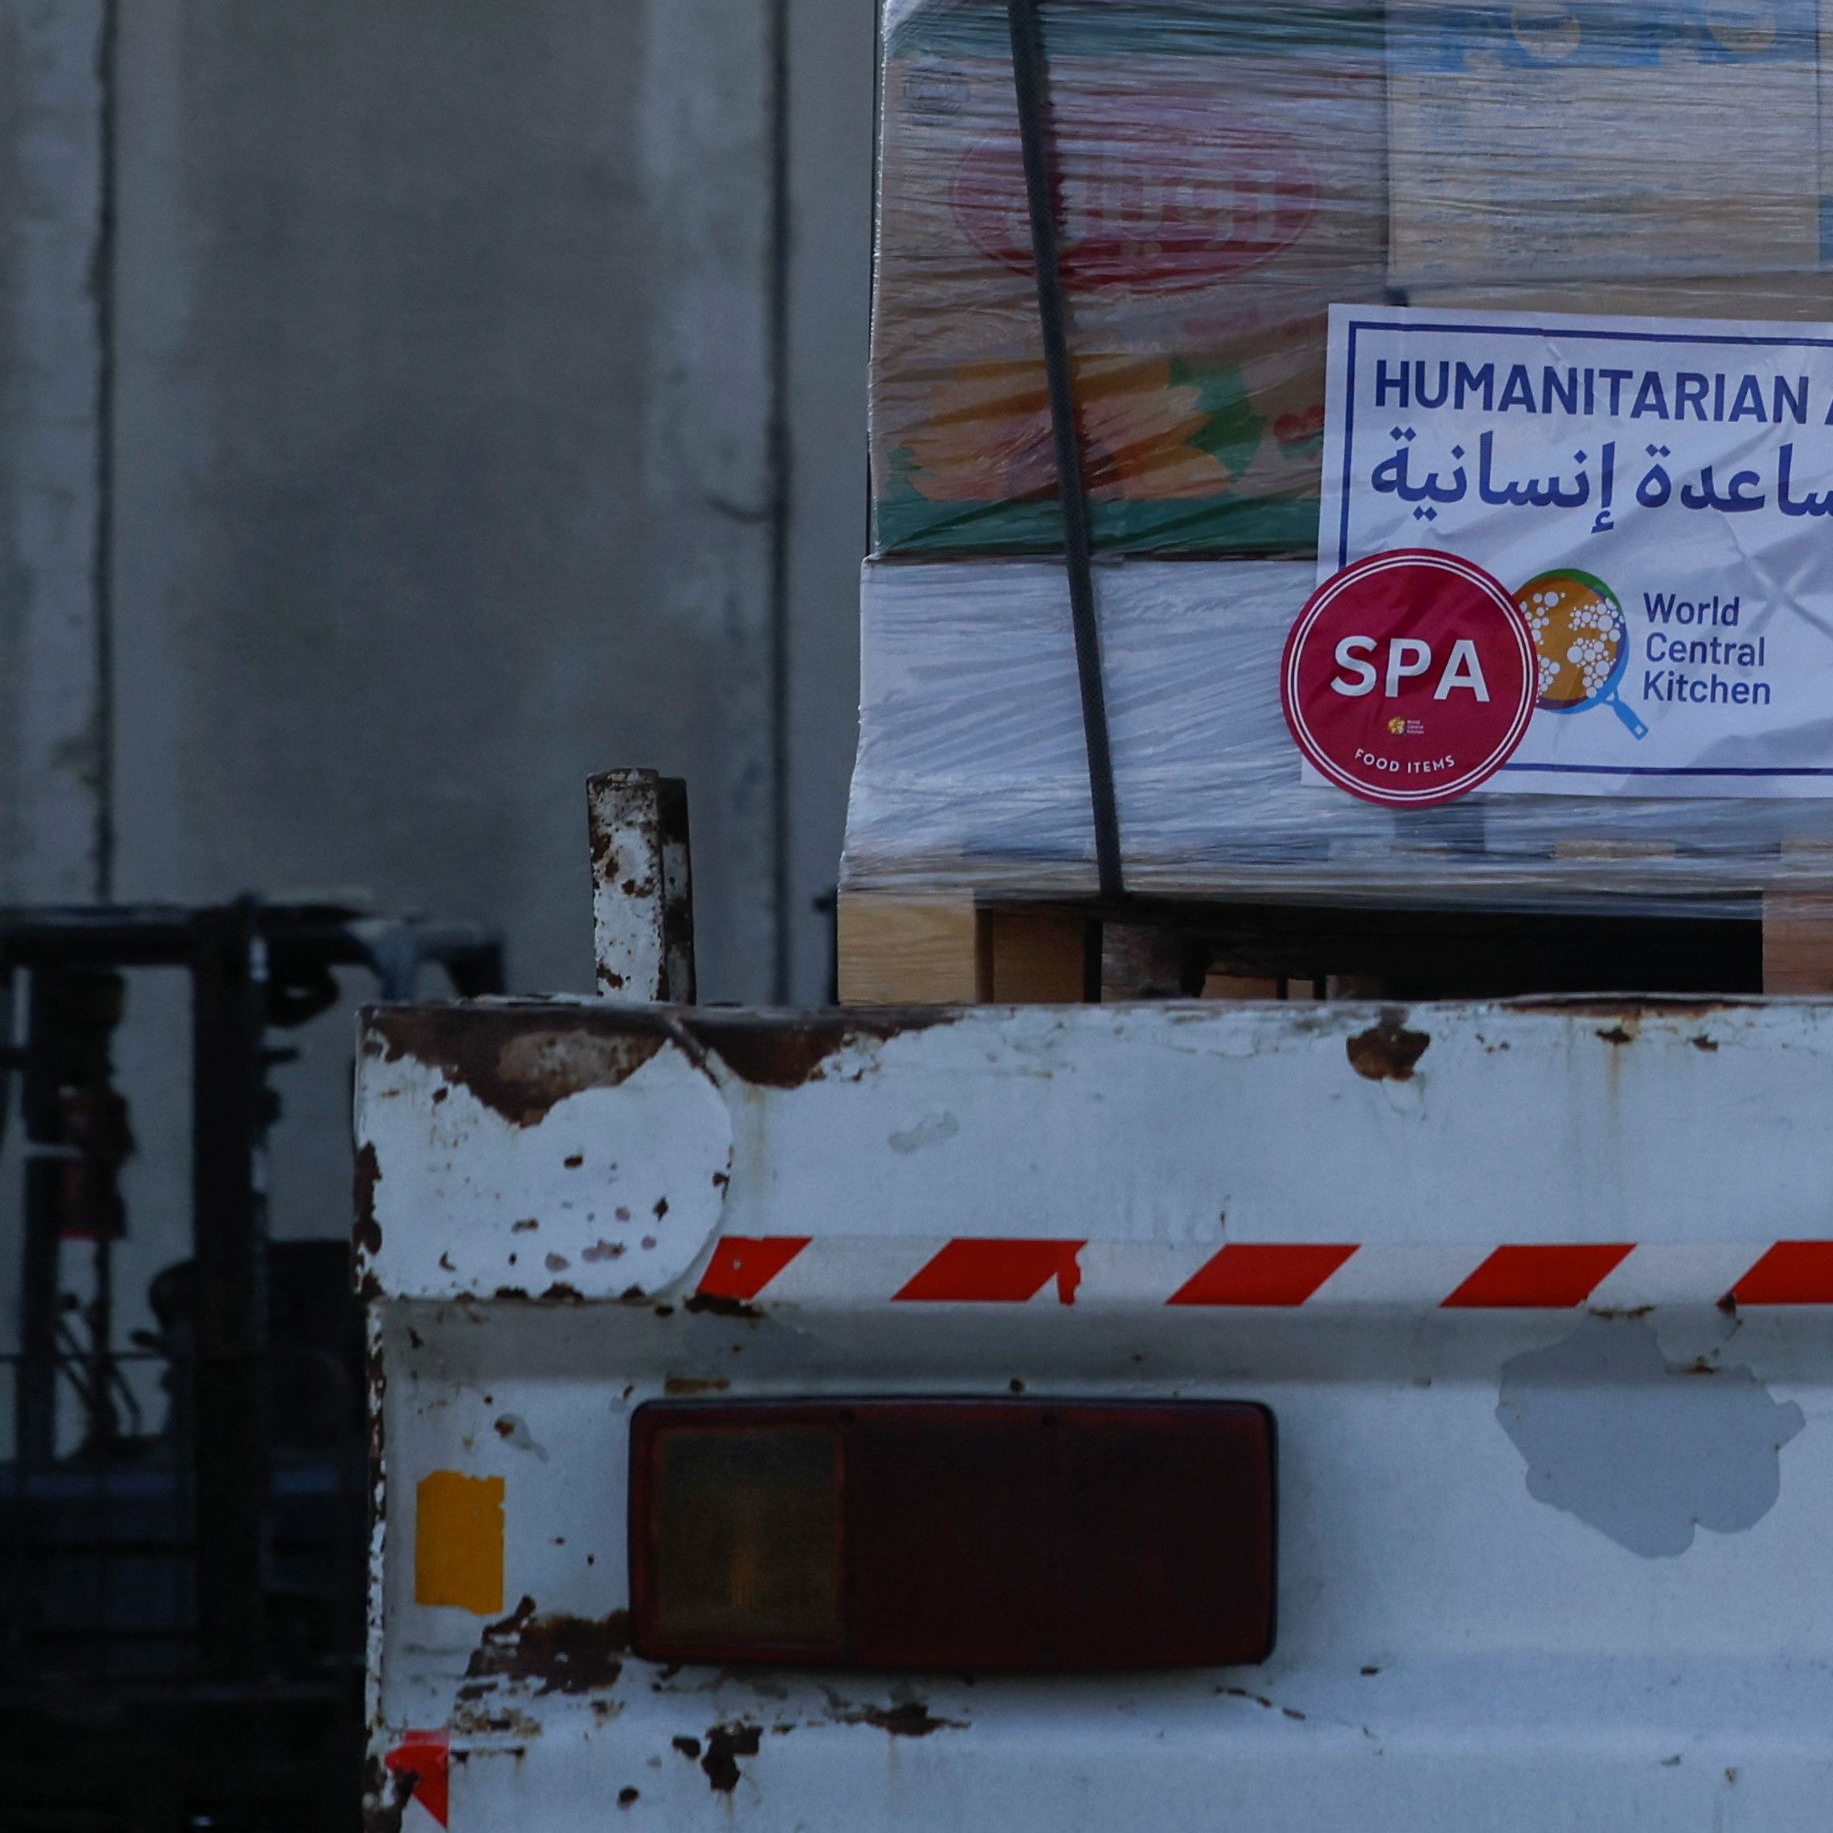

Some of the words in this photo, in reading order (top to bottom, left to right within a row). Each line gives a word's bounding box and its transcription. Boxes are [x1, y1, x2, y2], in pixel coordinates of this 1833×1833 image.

[1374, 358, 1809, 425] HUMANITARIAN
[1370, 426, 1616, 535] إنسانية
[1642, 592, 1741, 627] World
[1645, 632, 1766, 667] Central
[1330, 634, 1491, 703] SPA
[1643, 670, 1771, 706] Kitchen
[1354, 748, 1400, 773] FOOD
[1407, 754, 1456, 774] ITEMS
